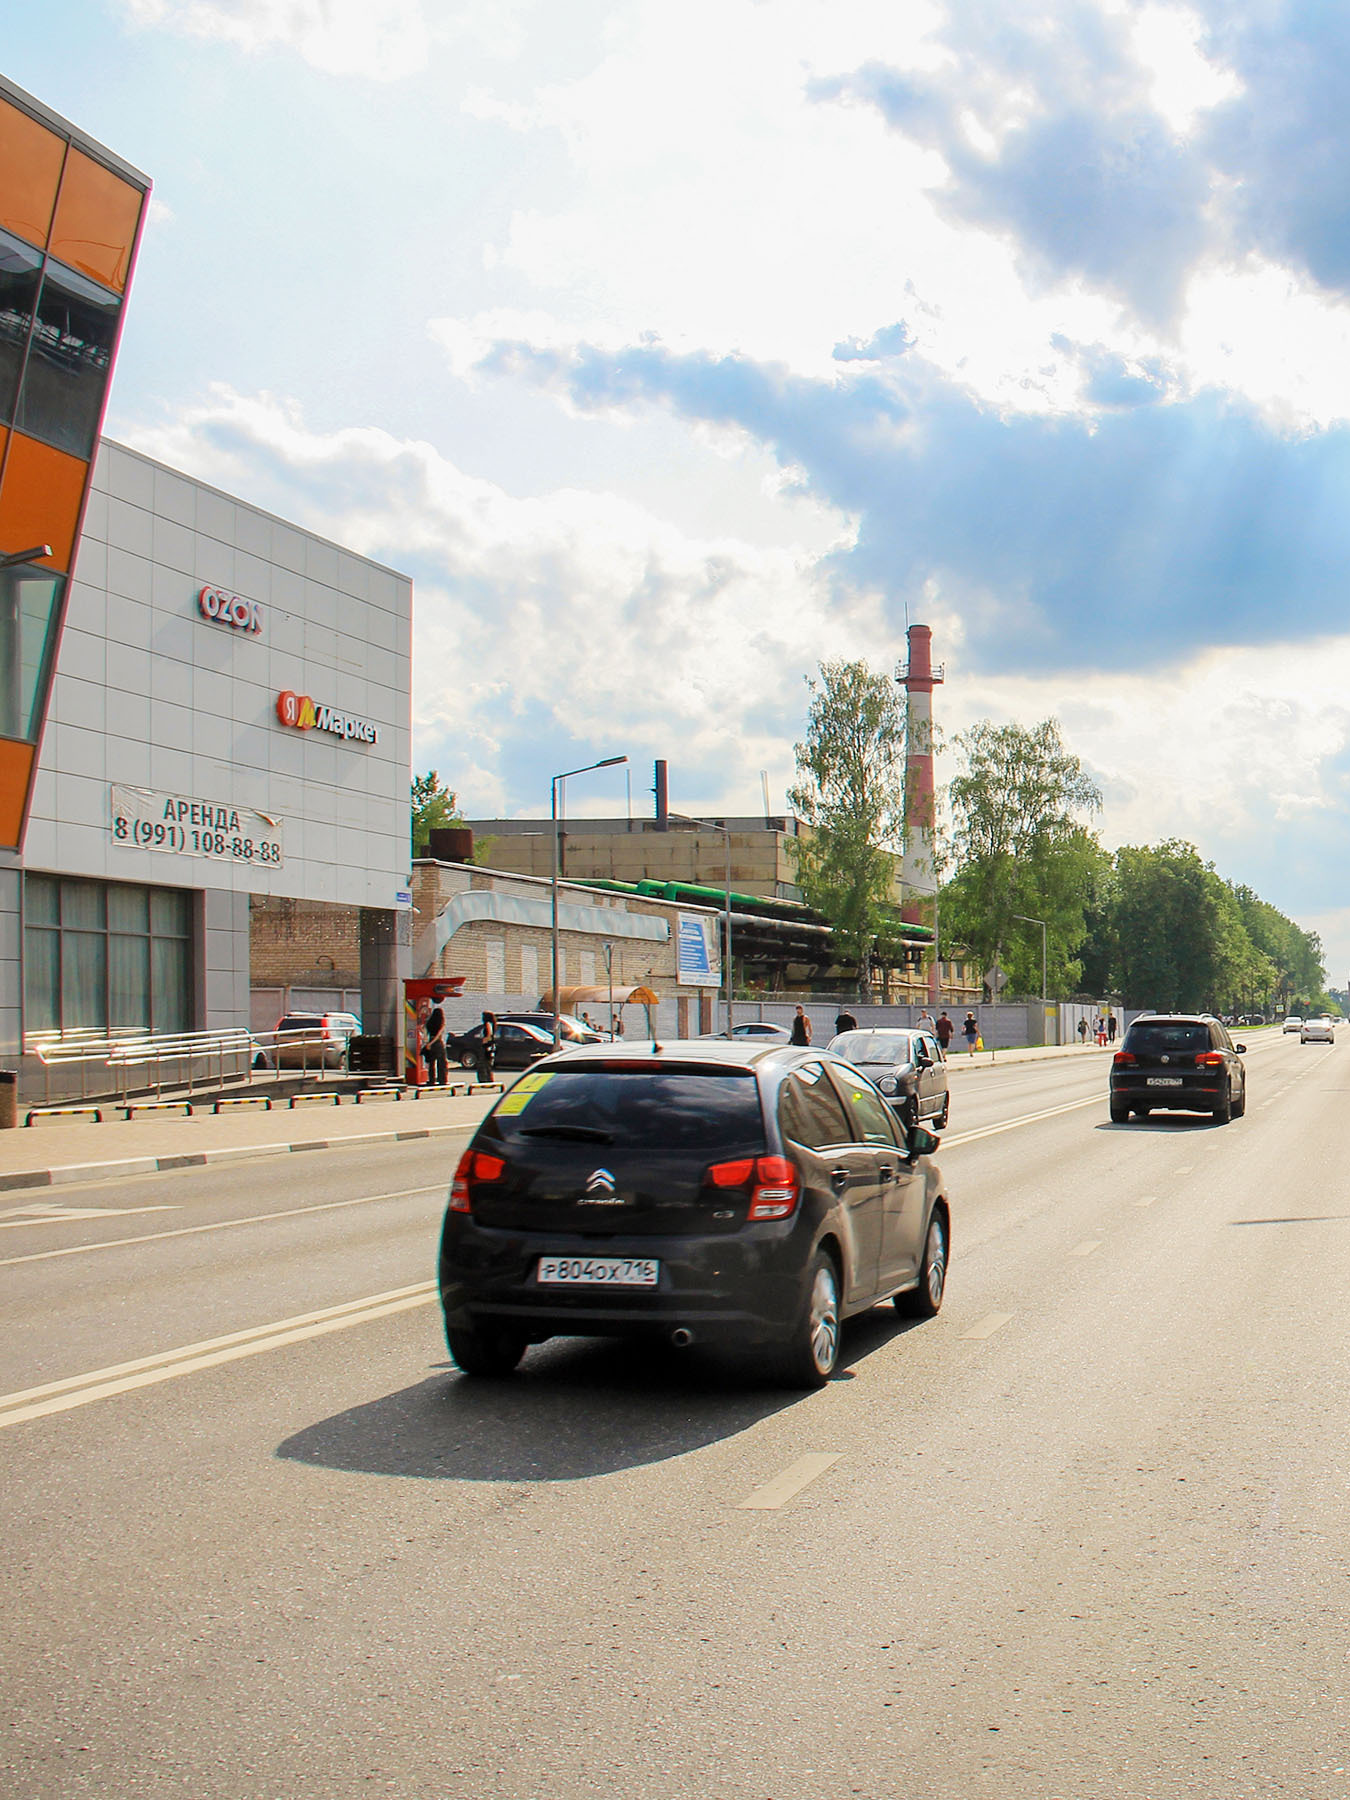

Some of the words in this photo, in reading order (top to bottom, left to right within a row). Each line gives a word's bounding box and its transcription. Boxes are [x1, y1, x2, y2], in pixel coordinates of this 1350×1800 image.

[200, 586, 265, 634] OZON
[316, 706, 381, 744] Маркет
[163, 799, 240, 833] АРЕНДА
[115, 816, 129, 839] 8
[133, 818, 185, 851] (991)
[191, 830, 281, 863] 108-88-88
